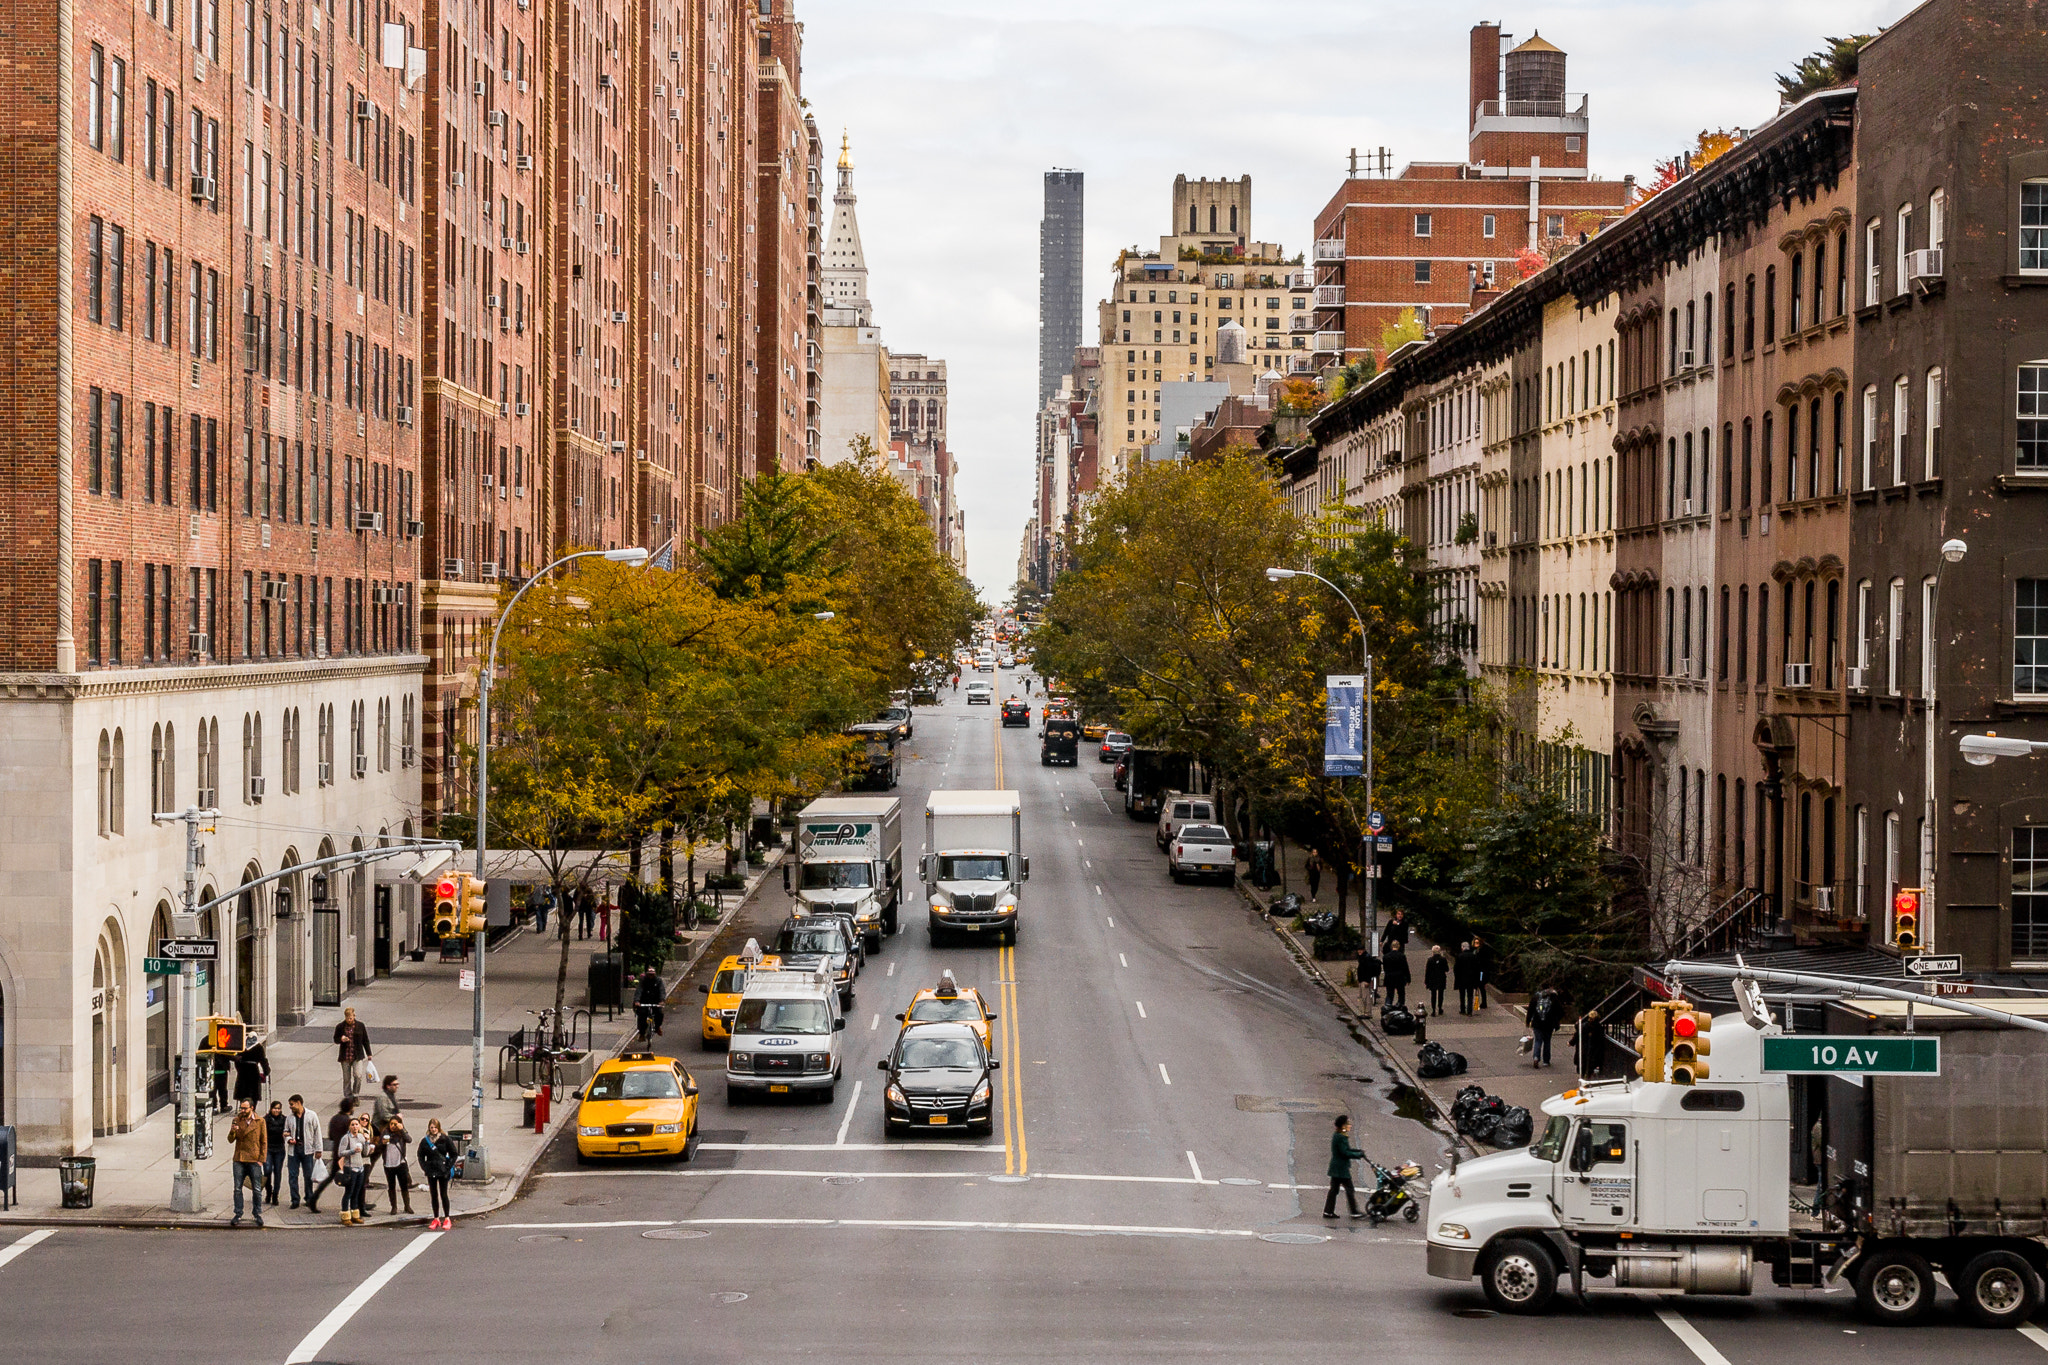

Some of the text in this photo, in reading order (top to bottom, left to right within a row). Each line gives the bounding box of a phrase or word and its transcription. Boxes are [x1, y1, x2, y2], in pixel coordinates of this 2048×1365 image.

[167, 945, 211, 954] ONE WAY
[148, 960, 161, 972] 10
[1913, 961, 1954, 971] ONE WAY
[1942, 984, 1953, 994] 10
[1811, 1045, 1879, 1065] 10 Av
